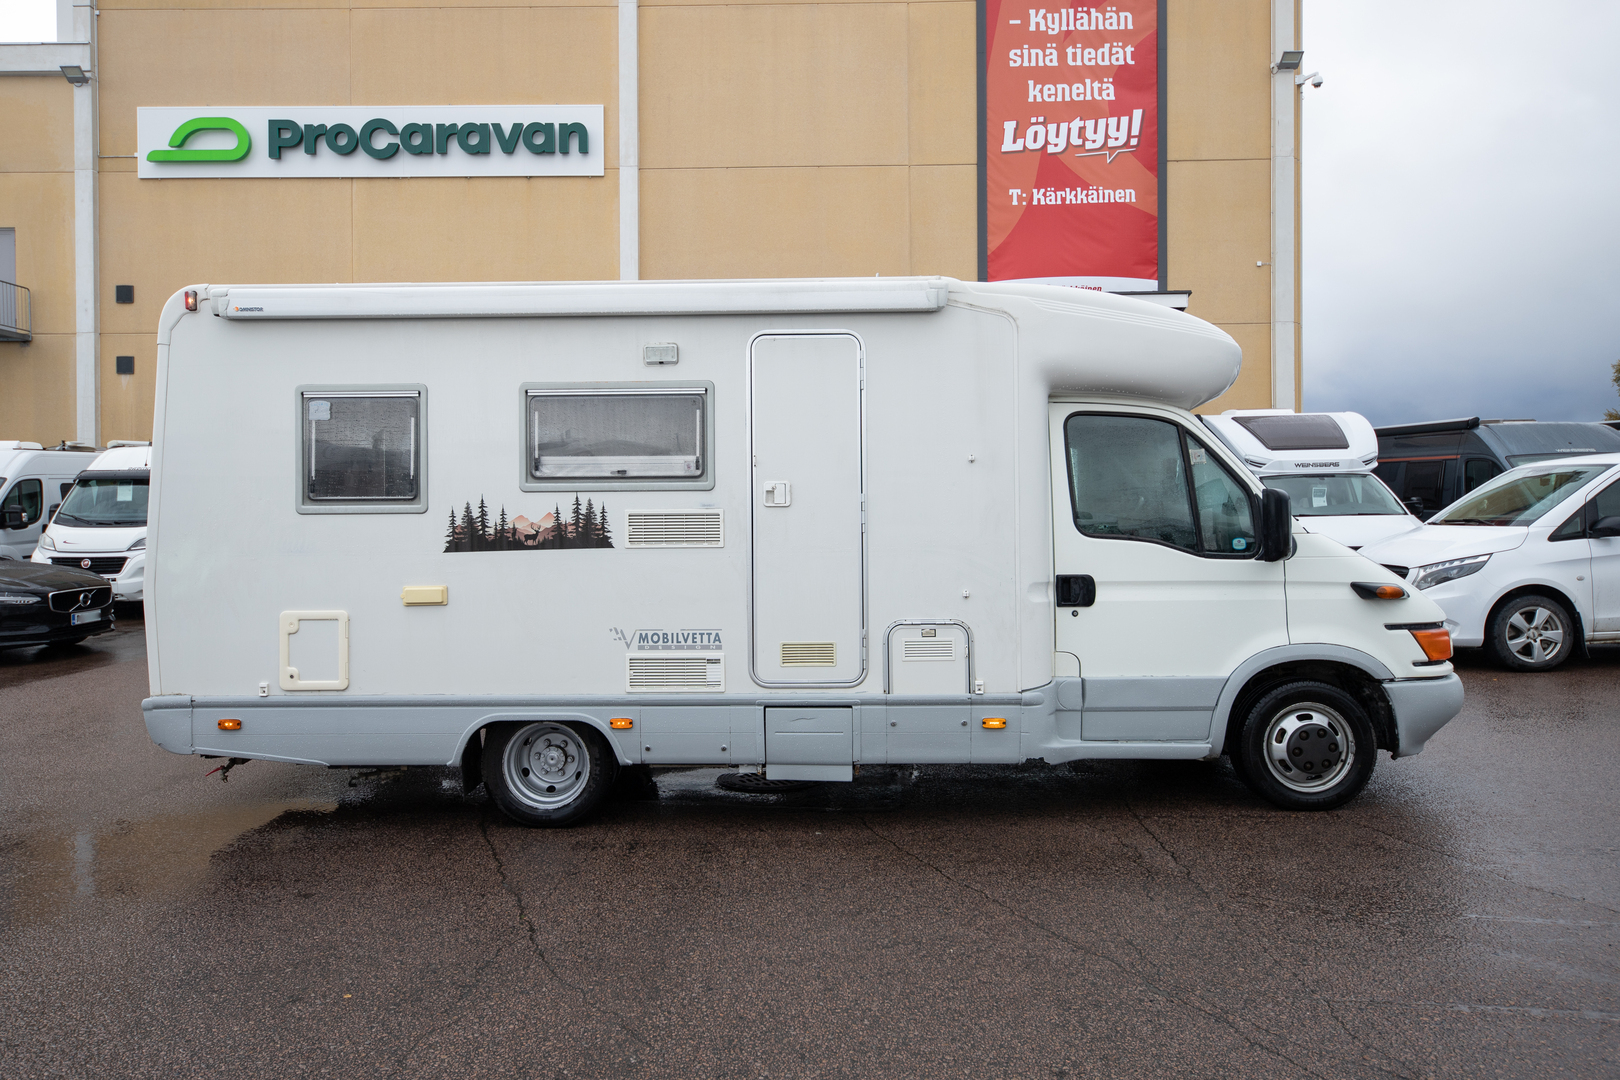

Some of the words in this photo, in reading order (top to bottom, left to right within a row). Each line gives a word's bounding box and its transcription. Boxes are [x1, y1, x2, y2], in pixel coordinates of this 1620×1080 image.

[1028, 6, 1133, 35] Kyllähän
[1009, 43, 1059, 67] sinä
[1066, 42, 1135, 66] tiedät
[1027, 77, 1116, 102] keneltä
[268, 117, 589, 160] ProCaravan
[1001, 108, 1144, 154] Löytyy!
[1008, 188, 1027, 206] T:
[1032, 185, 1136, 205] Kärkkäinen
[638, 632, 722, 644] MOBILVETTA
